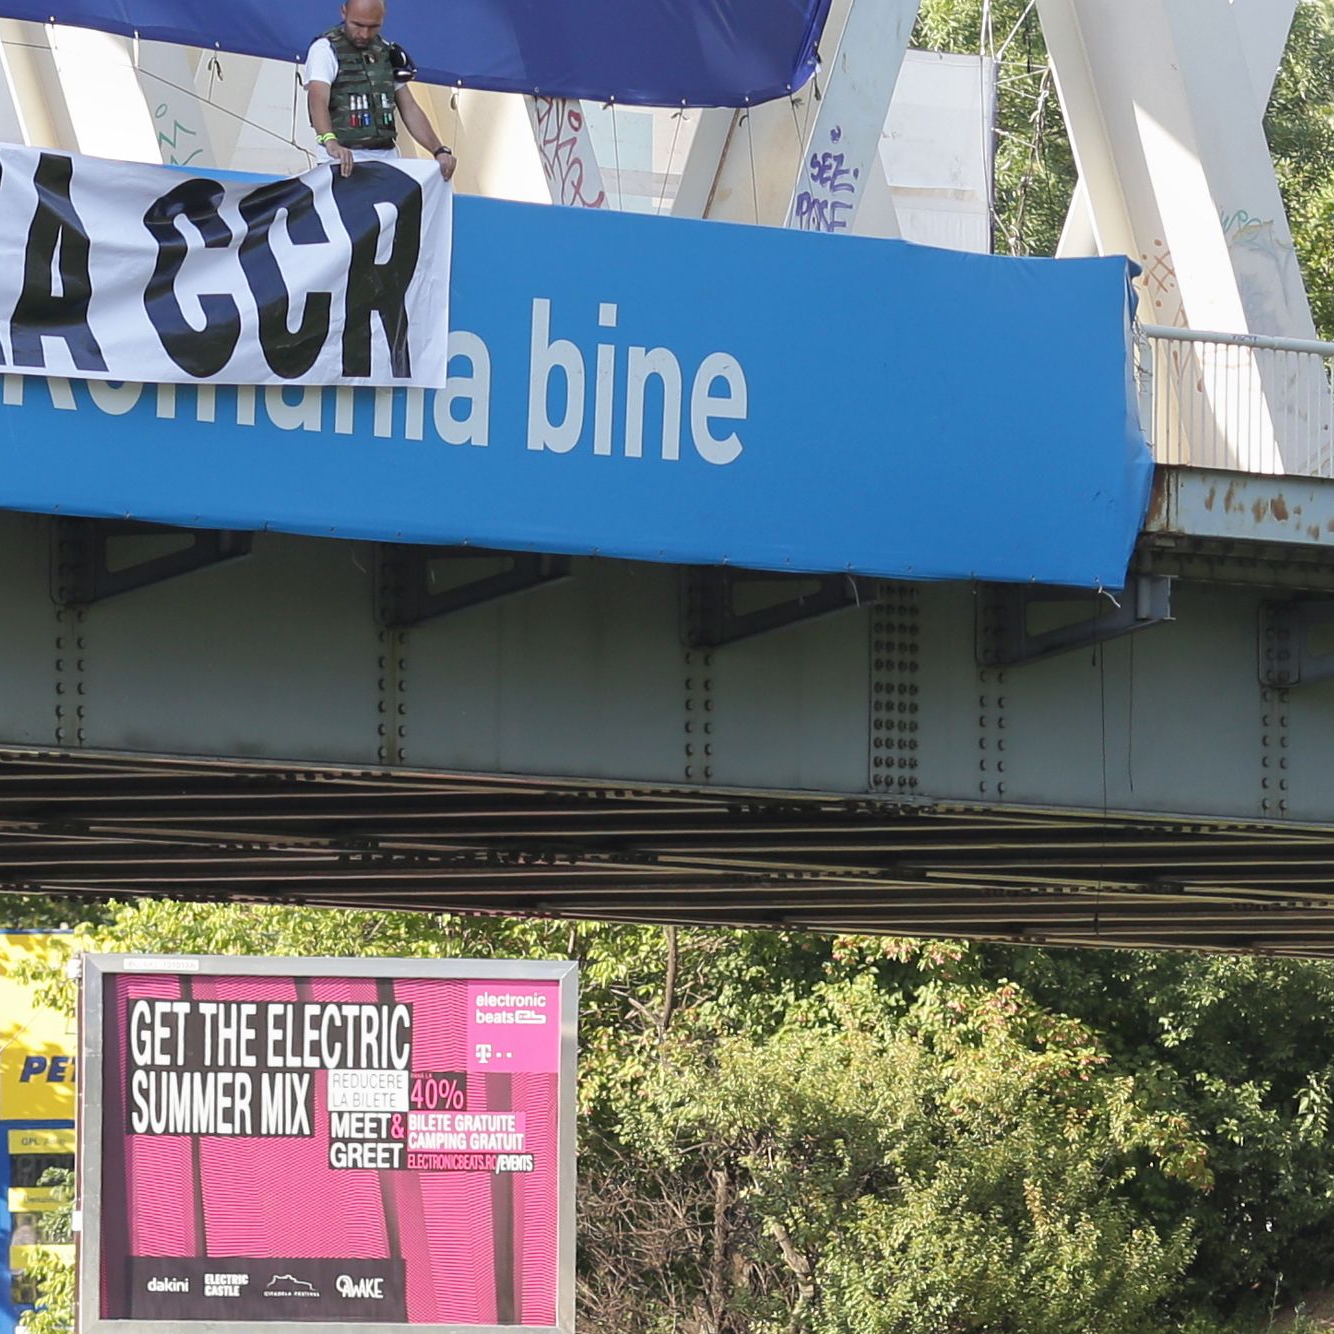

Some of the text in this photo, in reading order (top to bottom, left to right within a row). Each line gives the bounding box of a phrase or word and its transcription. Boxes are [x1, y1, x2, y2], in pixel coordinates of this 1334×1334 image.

[142, 160, 424, 380] CCR
[527, 298, 749, 466] bine
[475, 992, 547, 1007] electronic
[475, 1008, 514, 1024] beats
[131, 1000, 410, 1069] GET THE ELECTRIC
[332, 1073, 403, 1089] REDUCERE
[131, 1069, 311, 1135] SUMMER MIX
[333, 1092, 396, 1108] LA BILETE
[411, 1078, 464, 1110] 40%
[409, 1113, 516, 1132] BILETE GRATUITE
[408, 1133, 524, 1151] CAMPING GRATUIT
[329, 1141, 404, 1168] GREET
[147, 1277, 189, 1293] dakini
[204, 1273, 249, 1285] ELECTRIC
[204, 1285, 241, 1297] CASTLE
